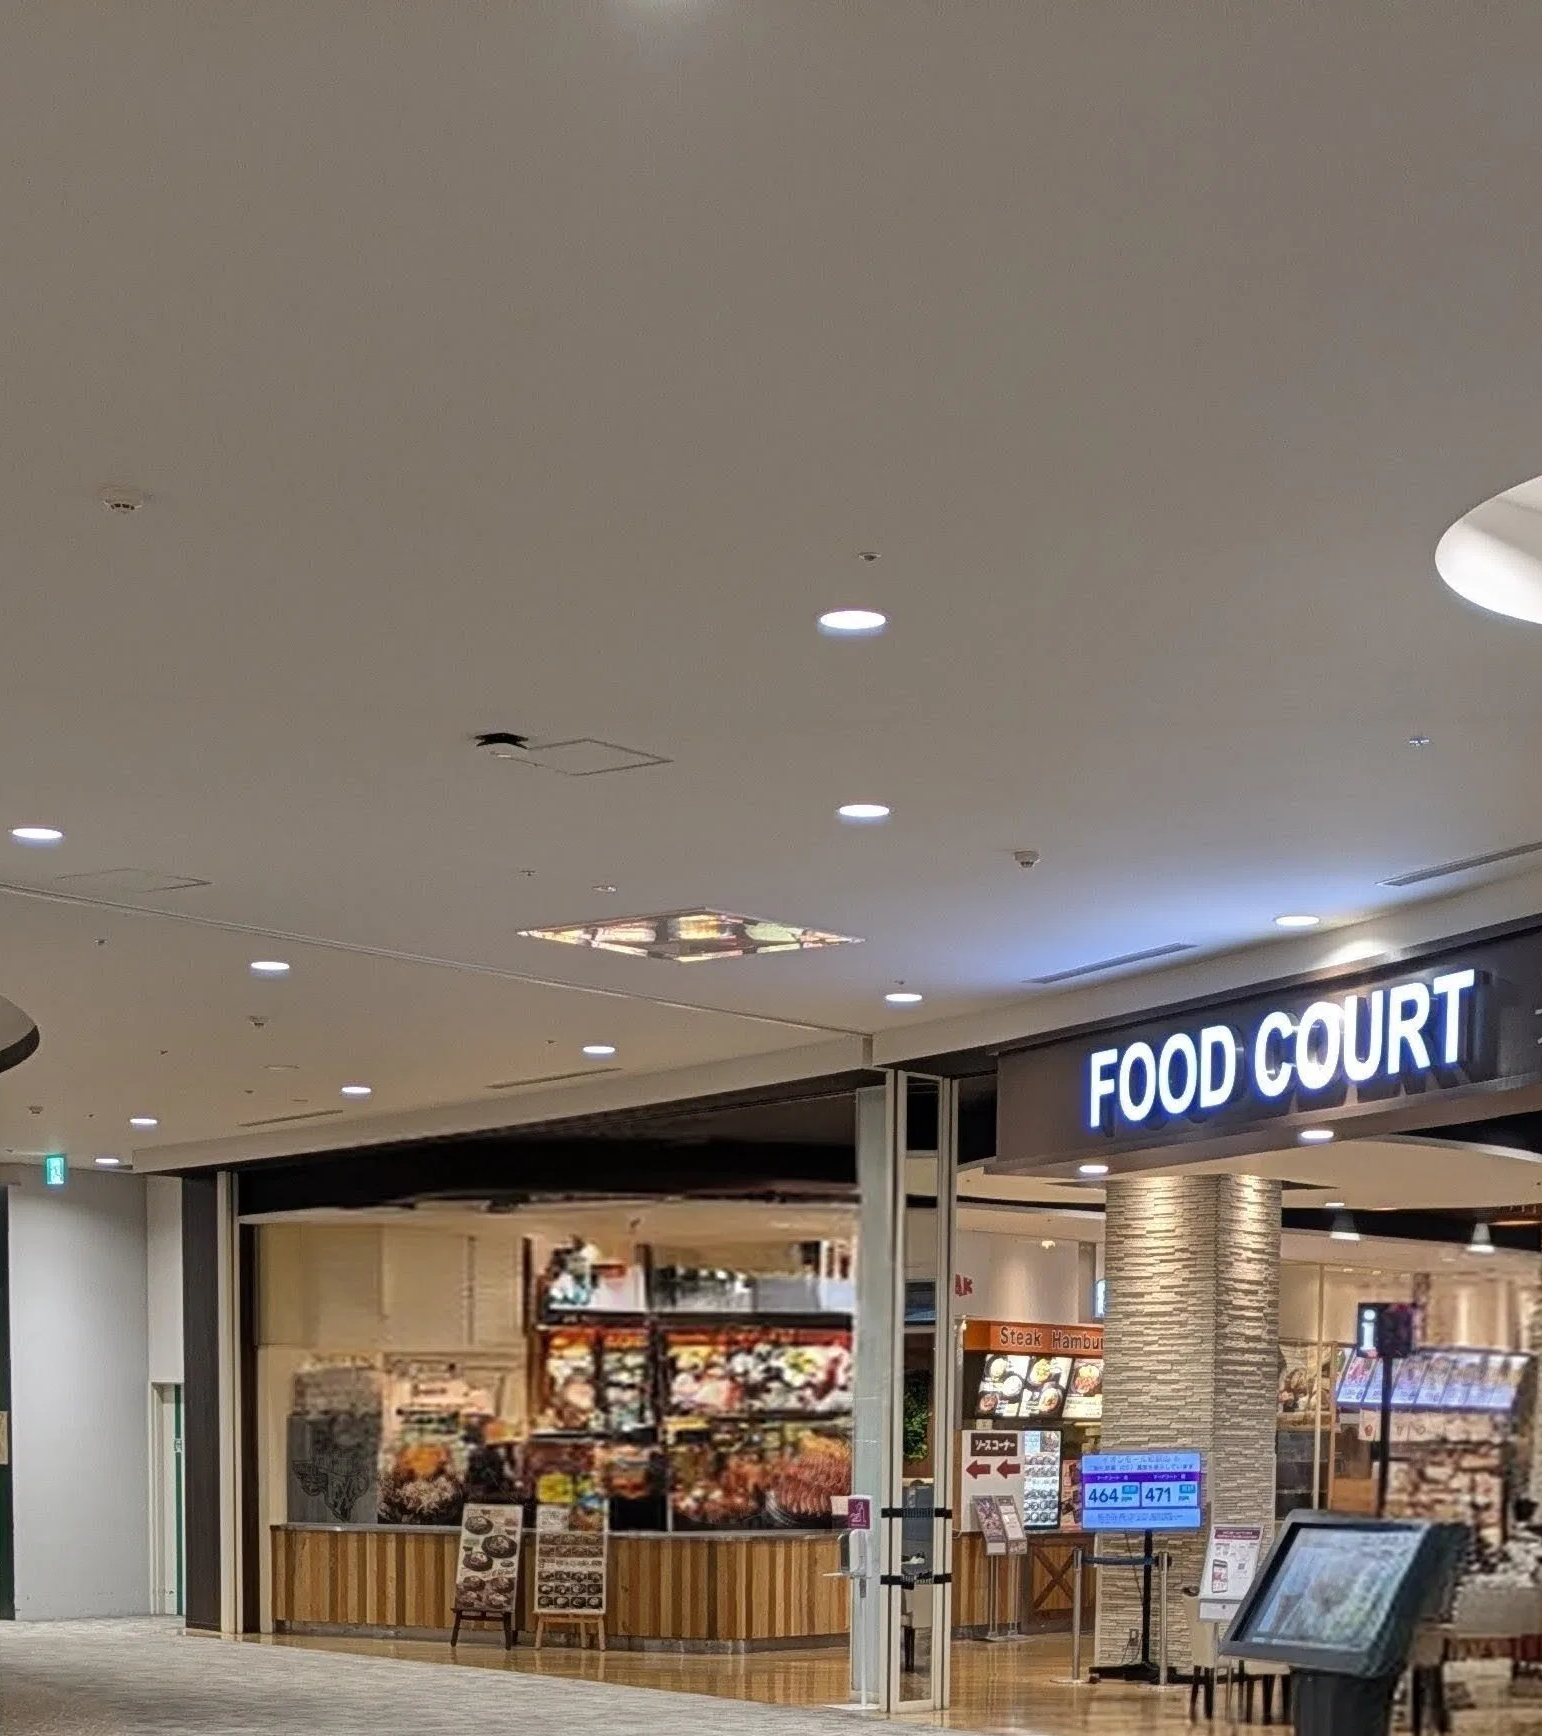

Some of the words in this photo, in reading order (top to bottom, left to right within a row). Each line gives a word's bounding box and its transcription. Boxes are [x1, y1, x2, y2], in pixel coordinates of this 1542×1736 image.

[1090, 1024, 1237, 1128] FOOD
[1254, 968, 1475, 1098] COURT
[1000, 1326, 1042, 1347] Steak
[975, 1439, 1016, 1452] ソースコーナー
[1088, 1487, 1119, 1503] 464
[1144, 1486, 1172, 1503] 471
